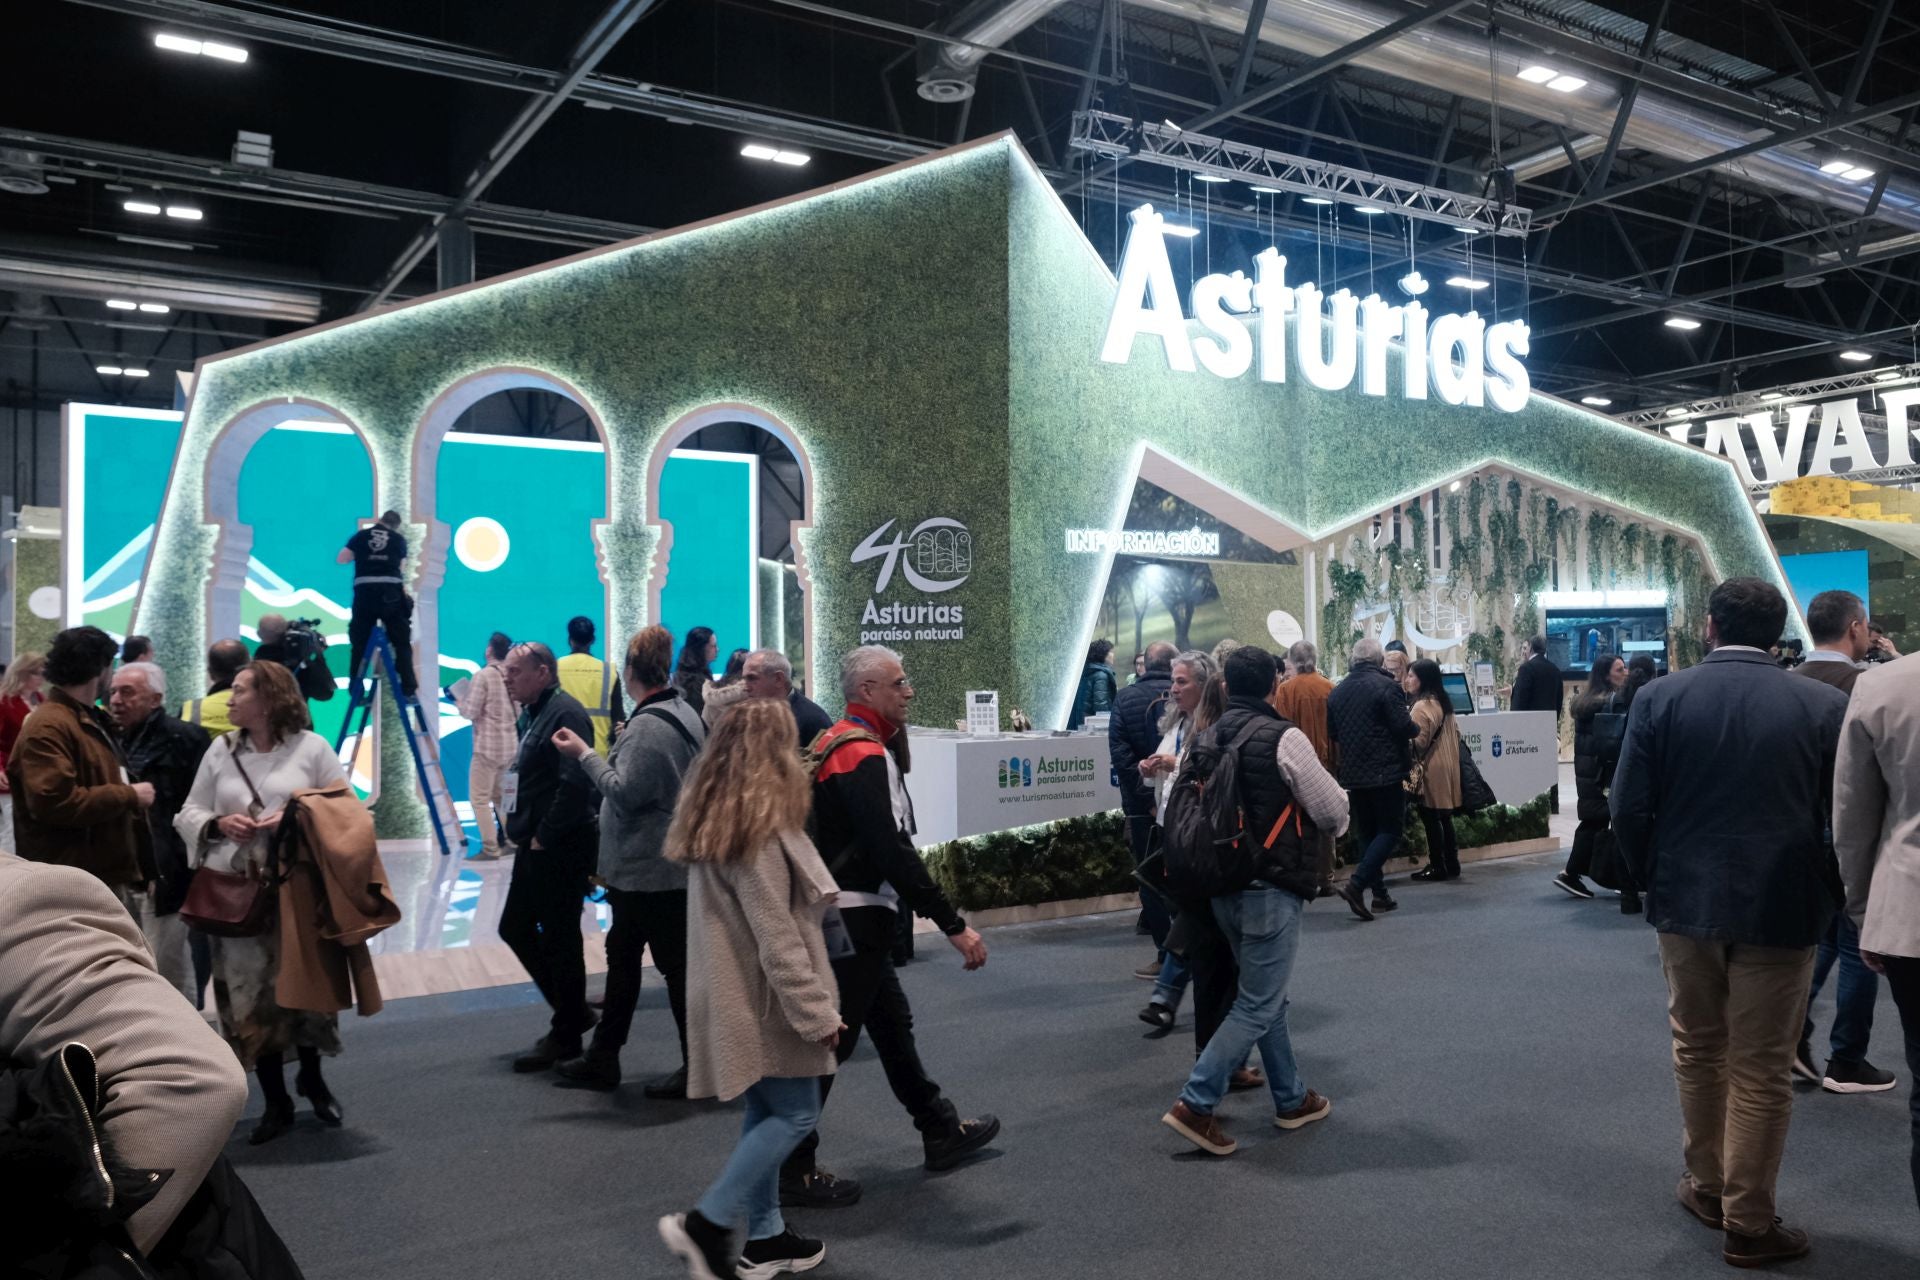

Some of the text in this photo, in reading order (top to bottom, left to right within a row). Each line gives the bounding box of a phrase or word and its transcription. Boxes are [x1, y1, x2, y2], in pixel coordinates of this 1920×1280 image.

[1101, 203, 1531, 413] Asturias
[1665, 388, 1920, 484] AVA
[1065, 526, 1220, 555] INFORMACIÓN
[860, 598, 963, 625] Asturias
[860, 626, 964, 644] paraíso natural
[1505, 745, 1539, 755] d'Asturies
[1037, 756, 1095, 774] Asturias
[1037, 772, 1095, 787] paraíso natural
[999, 790, 1096, 804] www.turismoasturias.es
